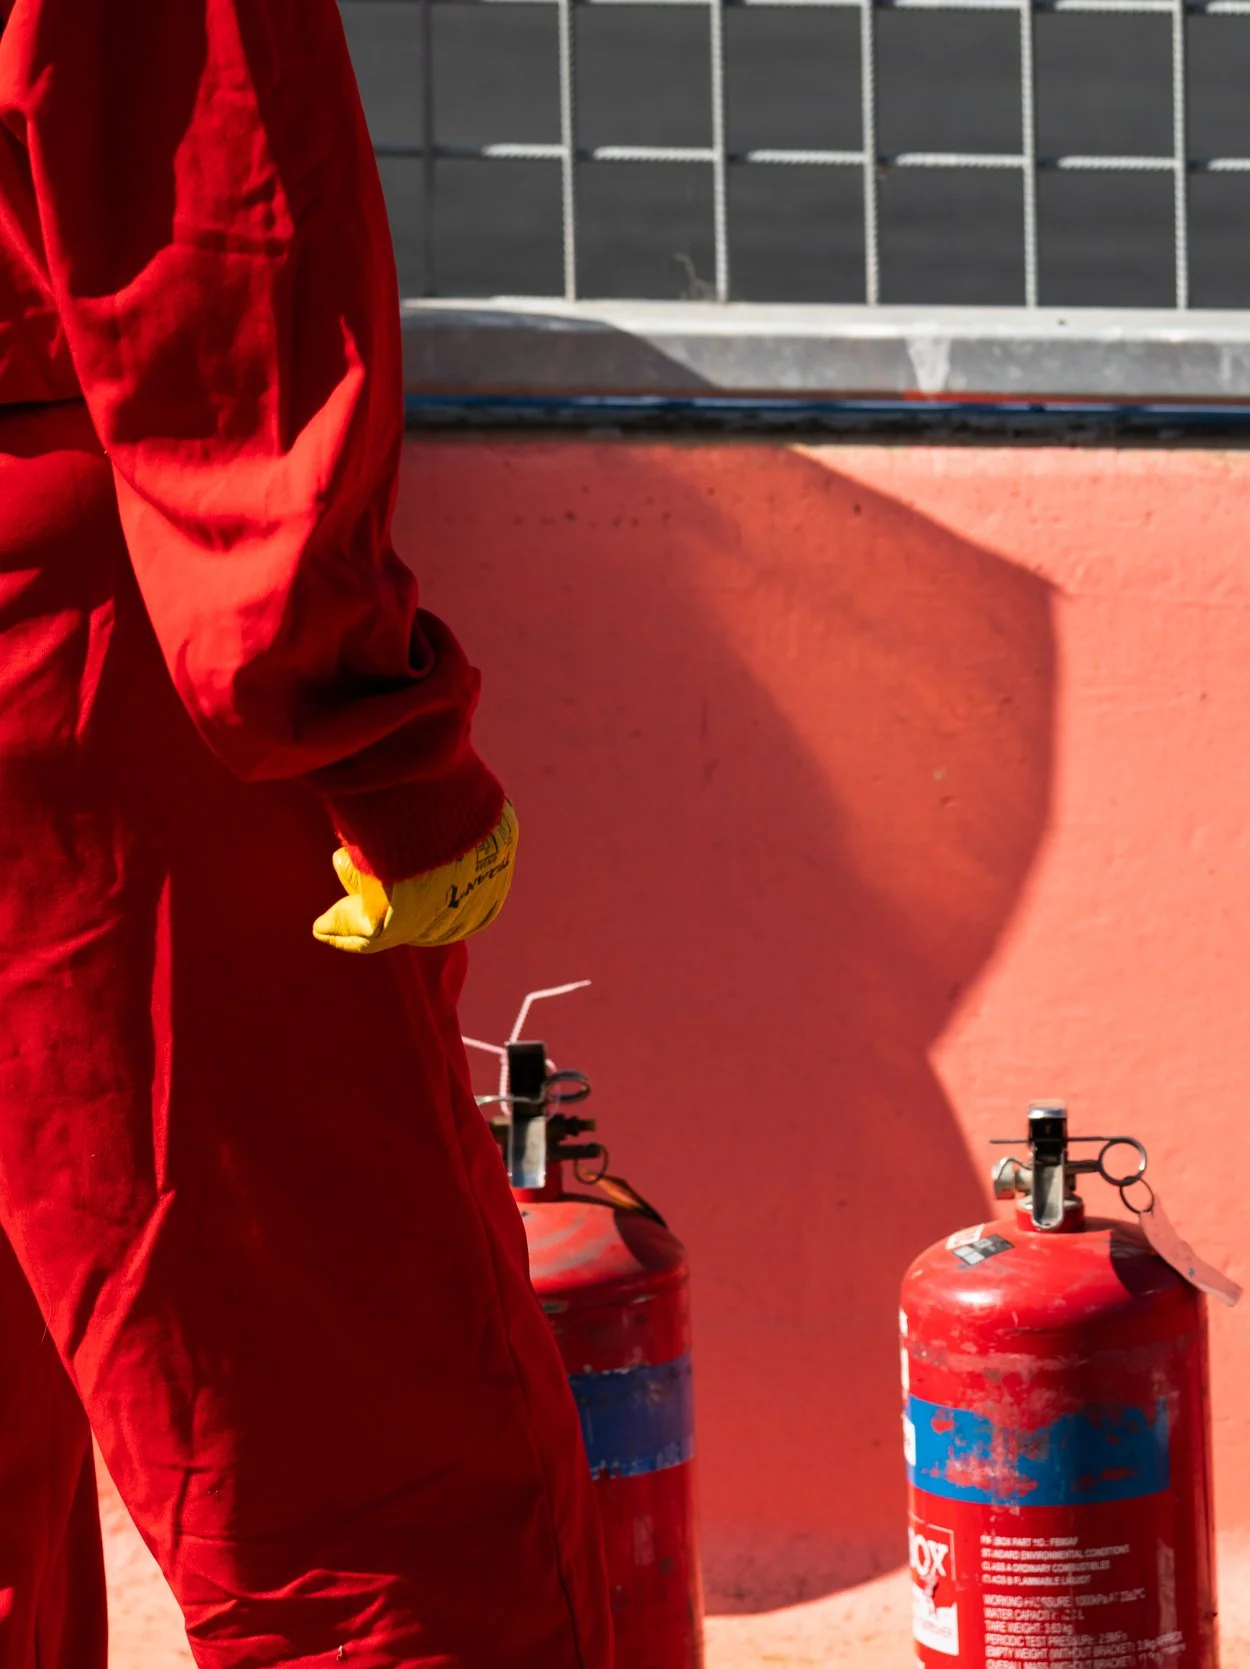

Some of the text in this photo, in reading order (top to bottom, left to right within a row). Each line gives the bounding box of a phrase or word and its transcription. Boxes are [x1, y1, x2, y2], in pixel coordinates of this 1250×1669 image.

[982, 1593, 1023, 1607] WORKING
[983, 1607, 1014, 1619] WATER
[984, 1619, 1007, 1633] TARE
[984, 1632, 1024, 1646] PERIODIC
[1025, 1634, 1046, 1647] TEST
[985, 1645, 1014, 1658] EMPTY
[1014, 1647, 1048, 1660] WEIGHT
